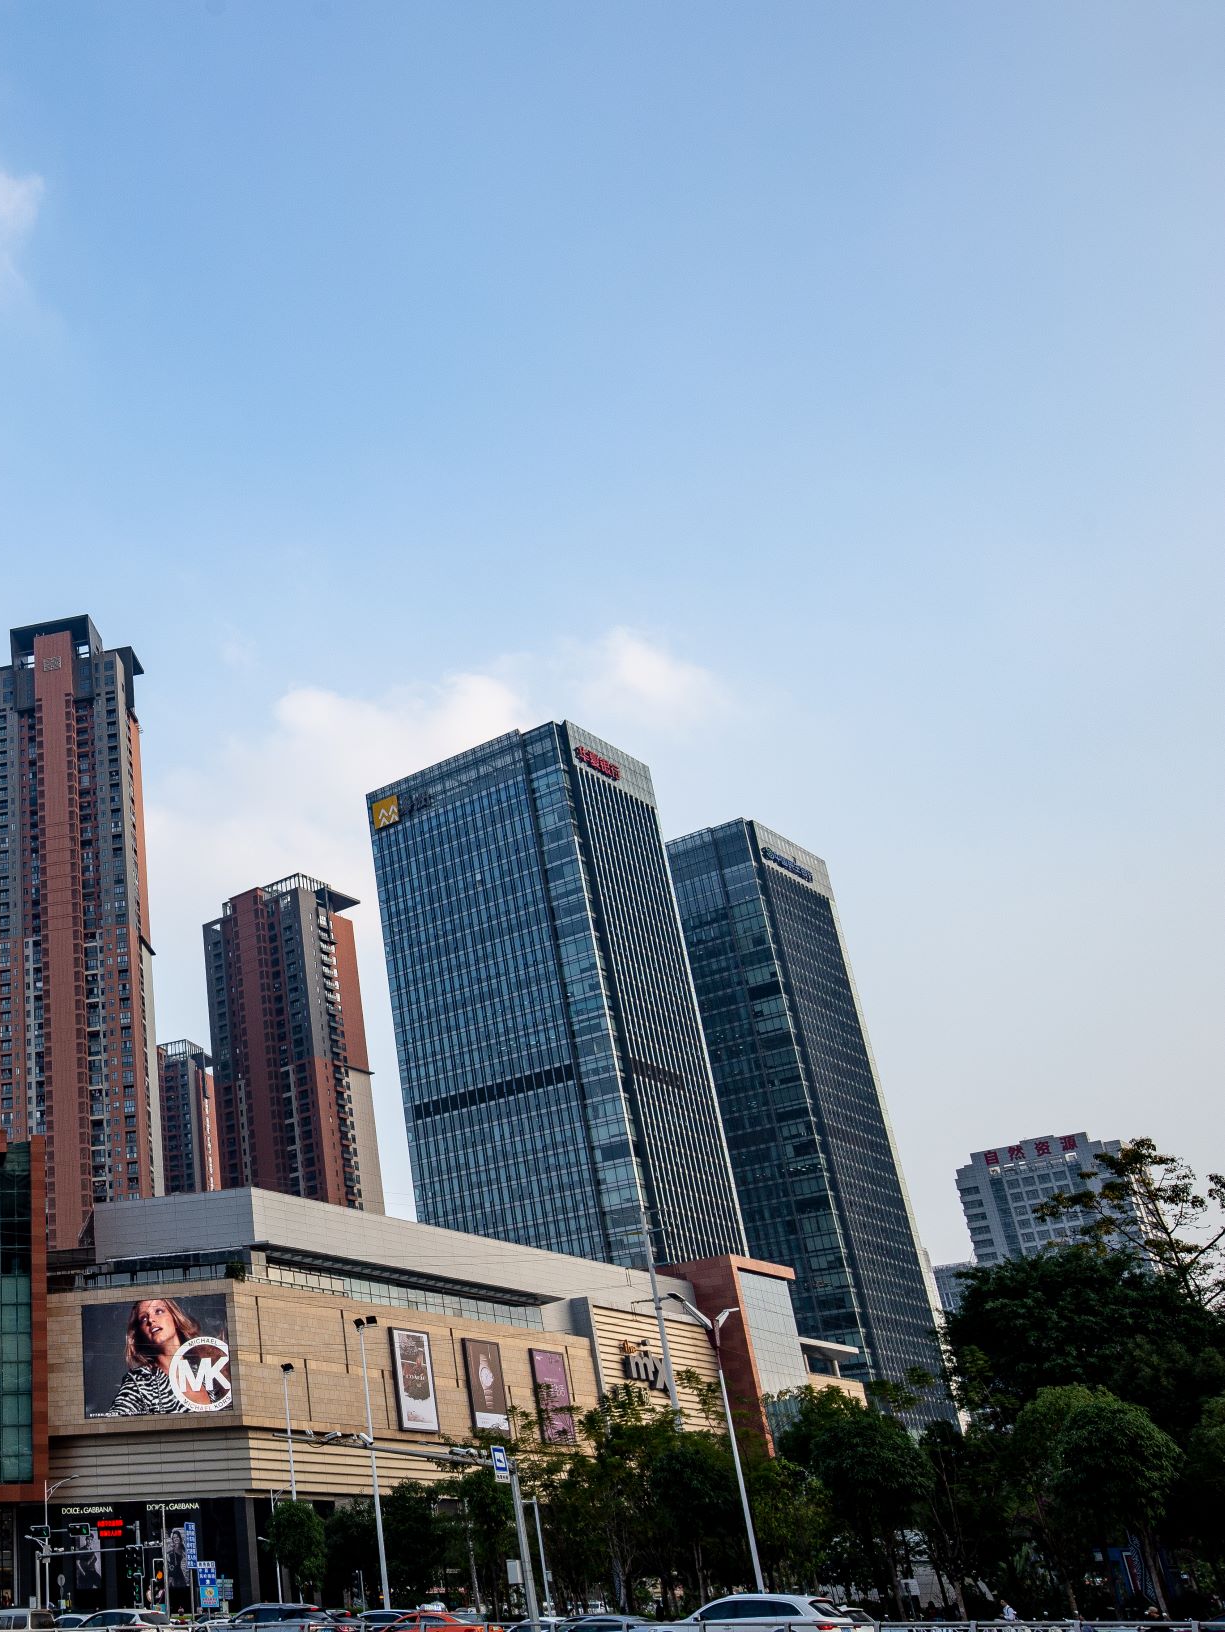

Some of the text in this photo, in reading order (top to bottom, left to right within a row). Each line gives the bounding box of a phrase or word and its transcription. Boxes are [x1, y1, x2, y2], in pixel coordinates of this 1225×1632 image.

[984, 1135, 1078, 1166] 自然资源
[188, 1337, 218, 1347] MICHAEL
[179, 1356, 232, 1393] MK
[183, 1395, 232, 1411] MICHAEL KORS
